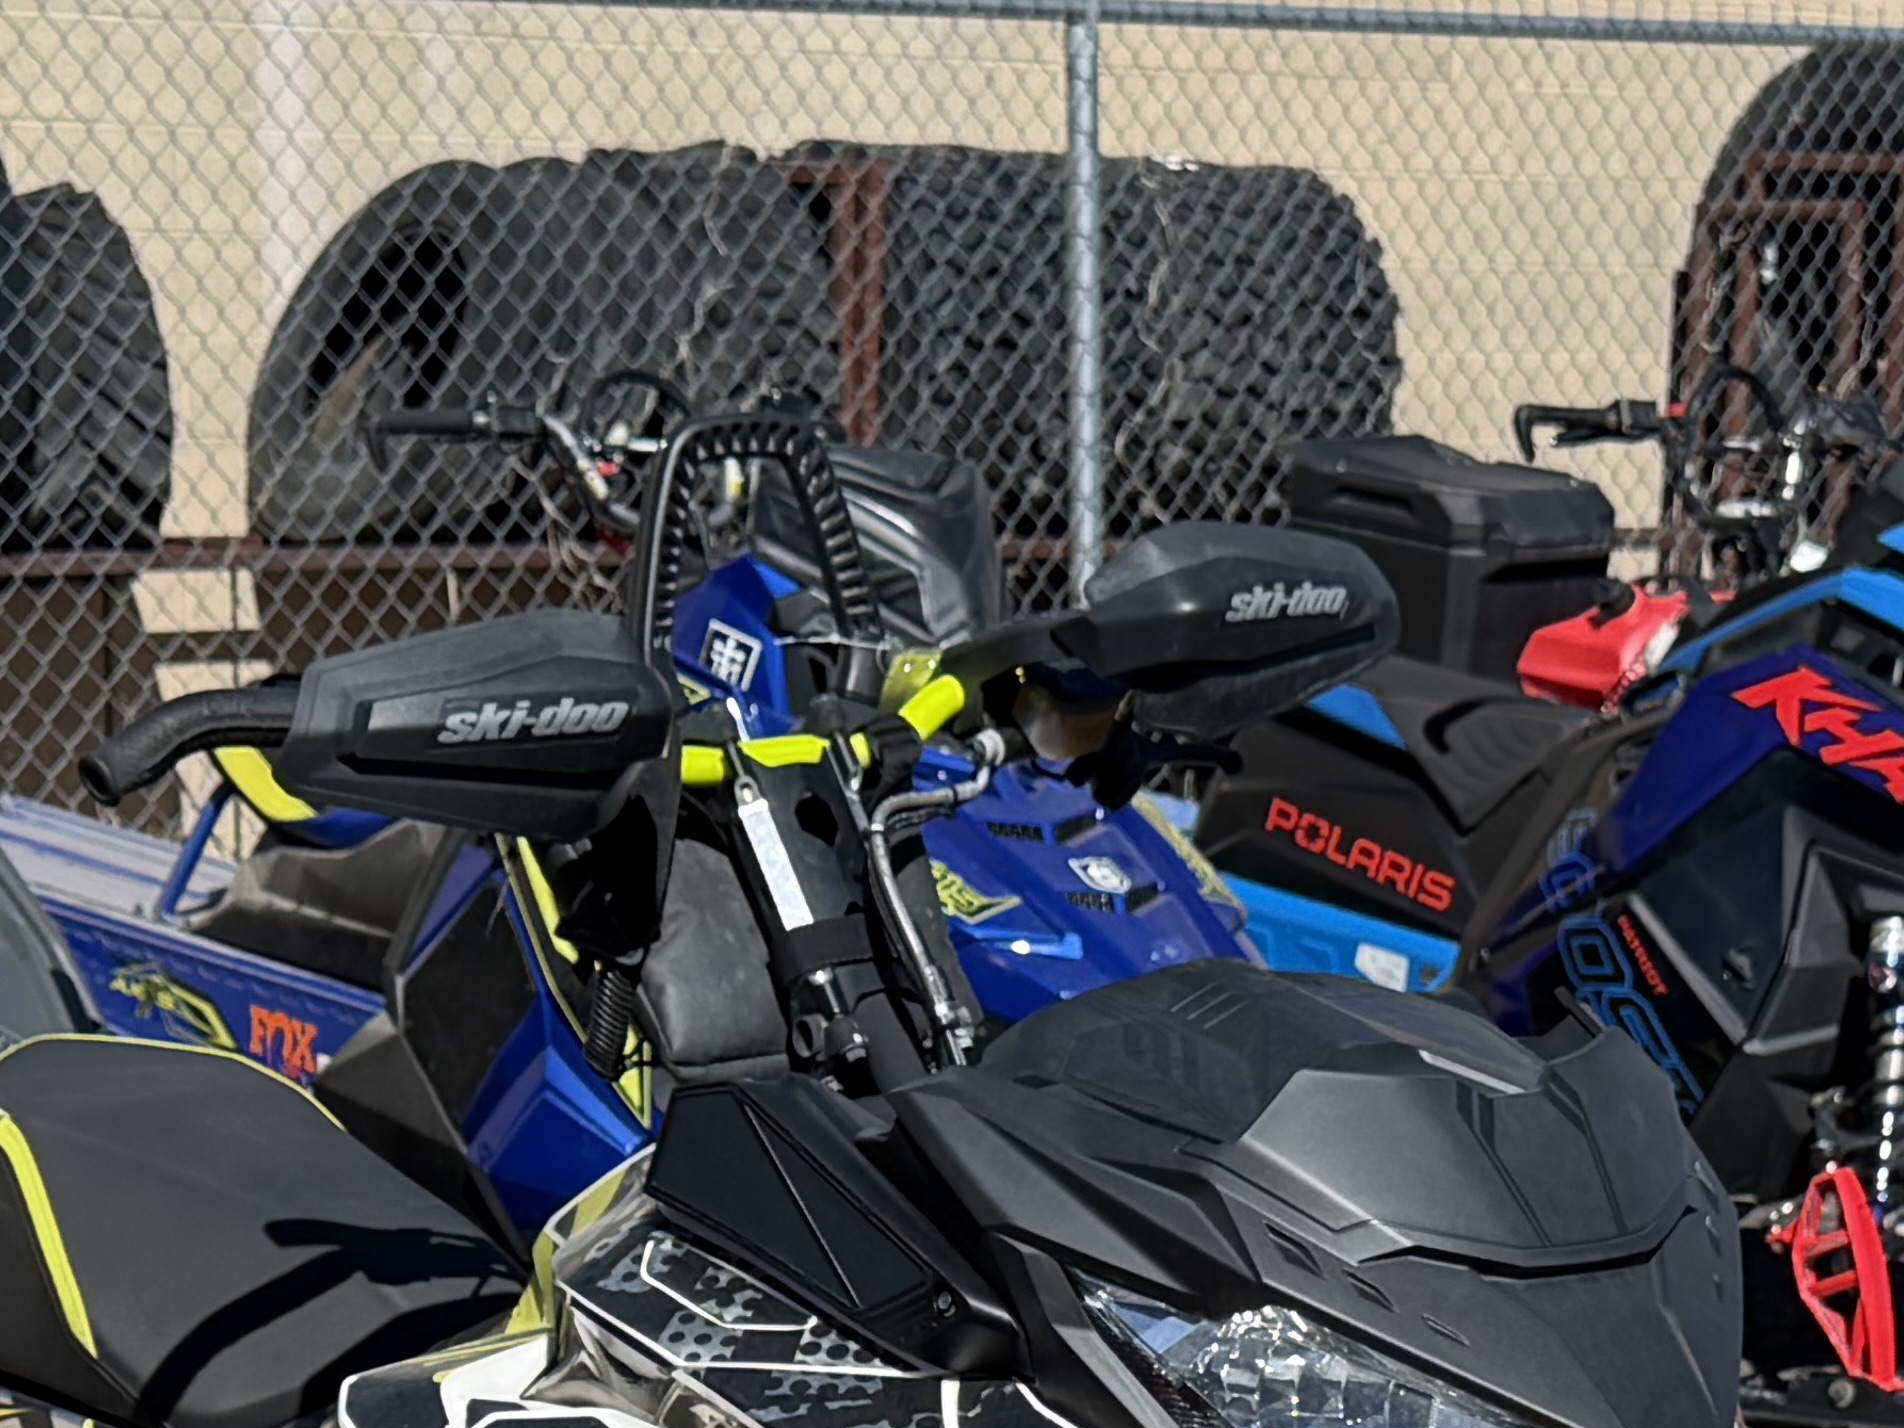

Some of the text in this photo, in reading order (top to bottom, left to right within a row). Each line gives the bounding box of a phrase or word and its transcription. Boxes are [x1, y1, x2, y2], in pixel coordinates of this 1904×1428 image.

[1225, 580, 1347, 622] ski-doo
[437, 697, 629, 743] ski-doo
[1265, 797, 1456, 912] POLARIS
[250, 1003, 318, 1078] FOX
